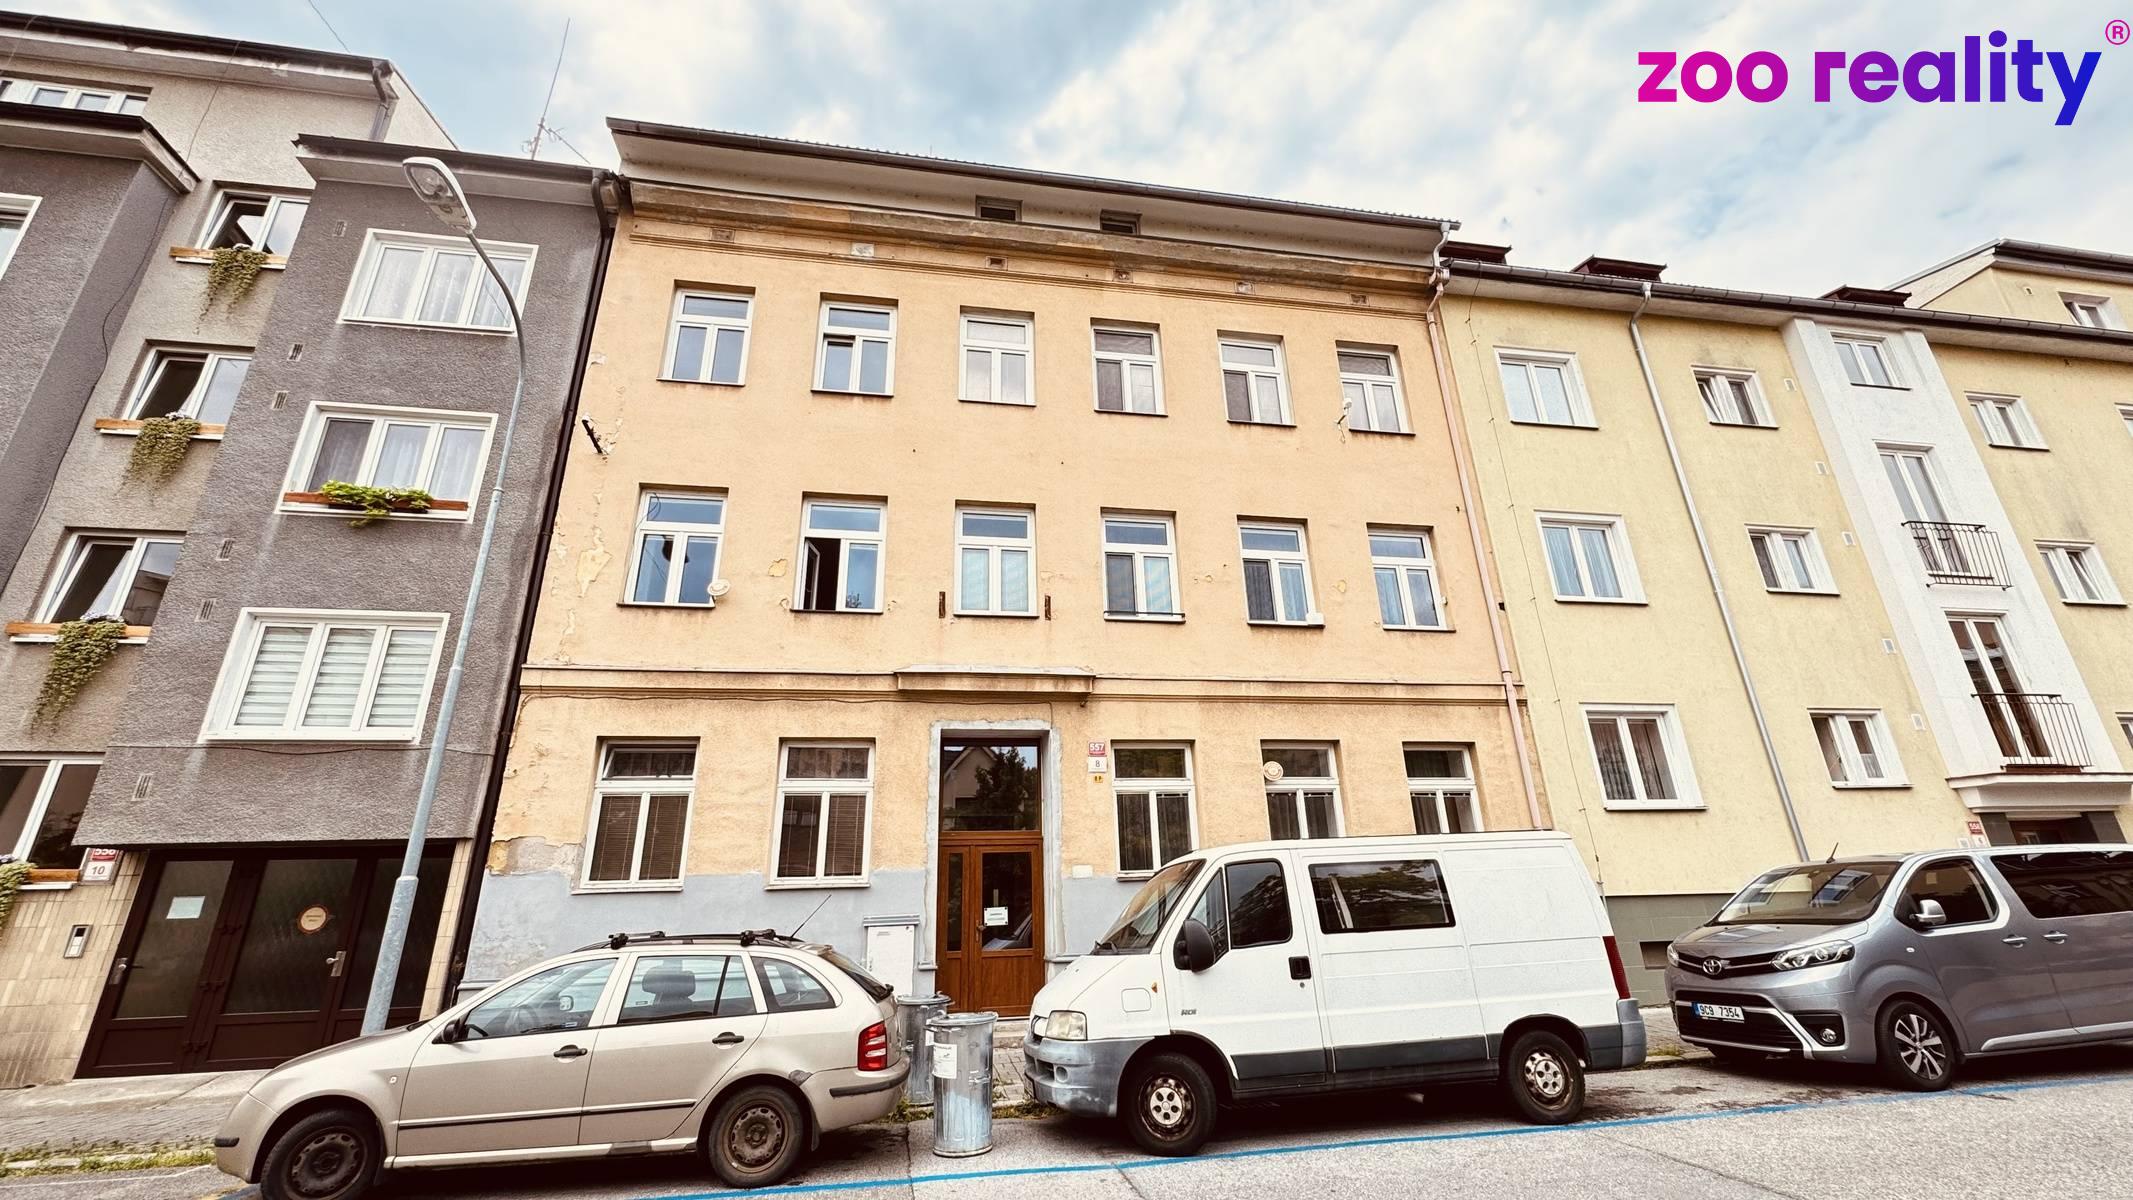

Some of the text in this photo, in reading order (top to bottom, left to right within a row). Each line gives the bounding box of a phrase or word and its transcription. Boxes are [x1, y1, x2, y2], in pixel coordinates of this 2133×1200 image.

[1089, 742, 1105, 751] 557
[91, 865, 106, 875] 10
[1699, 1004, 1740, 1018] 9C9 7354
